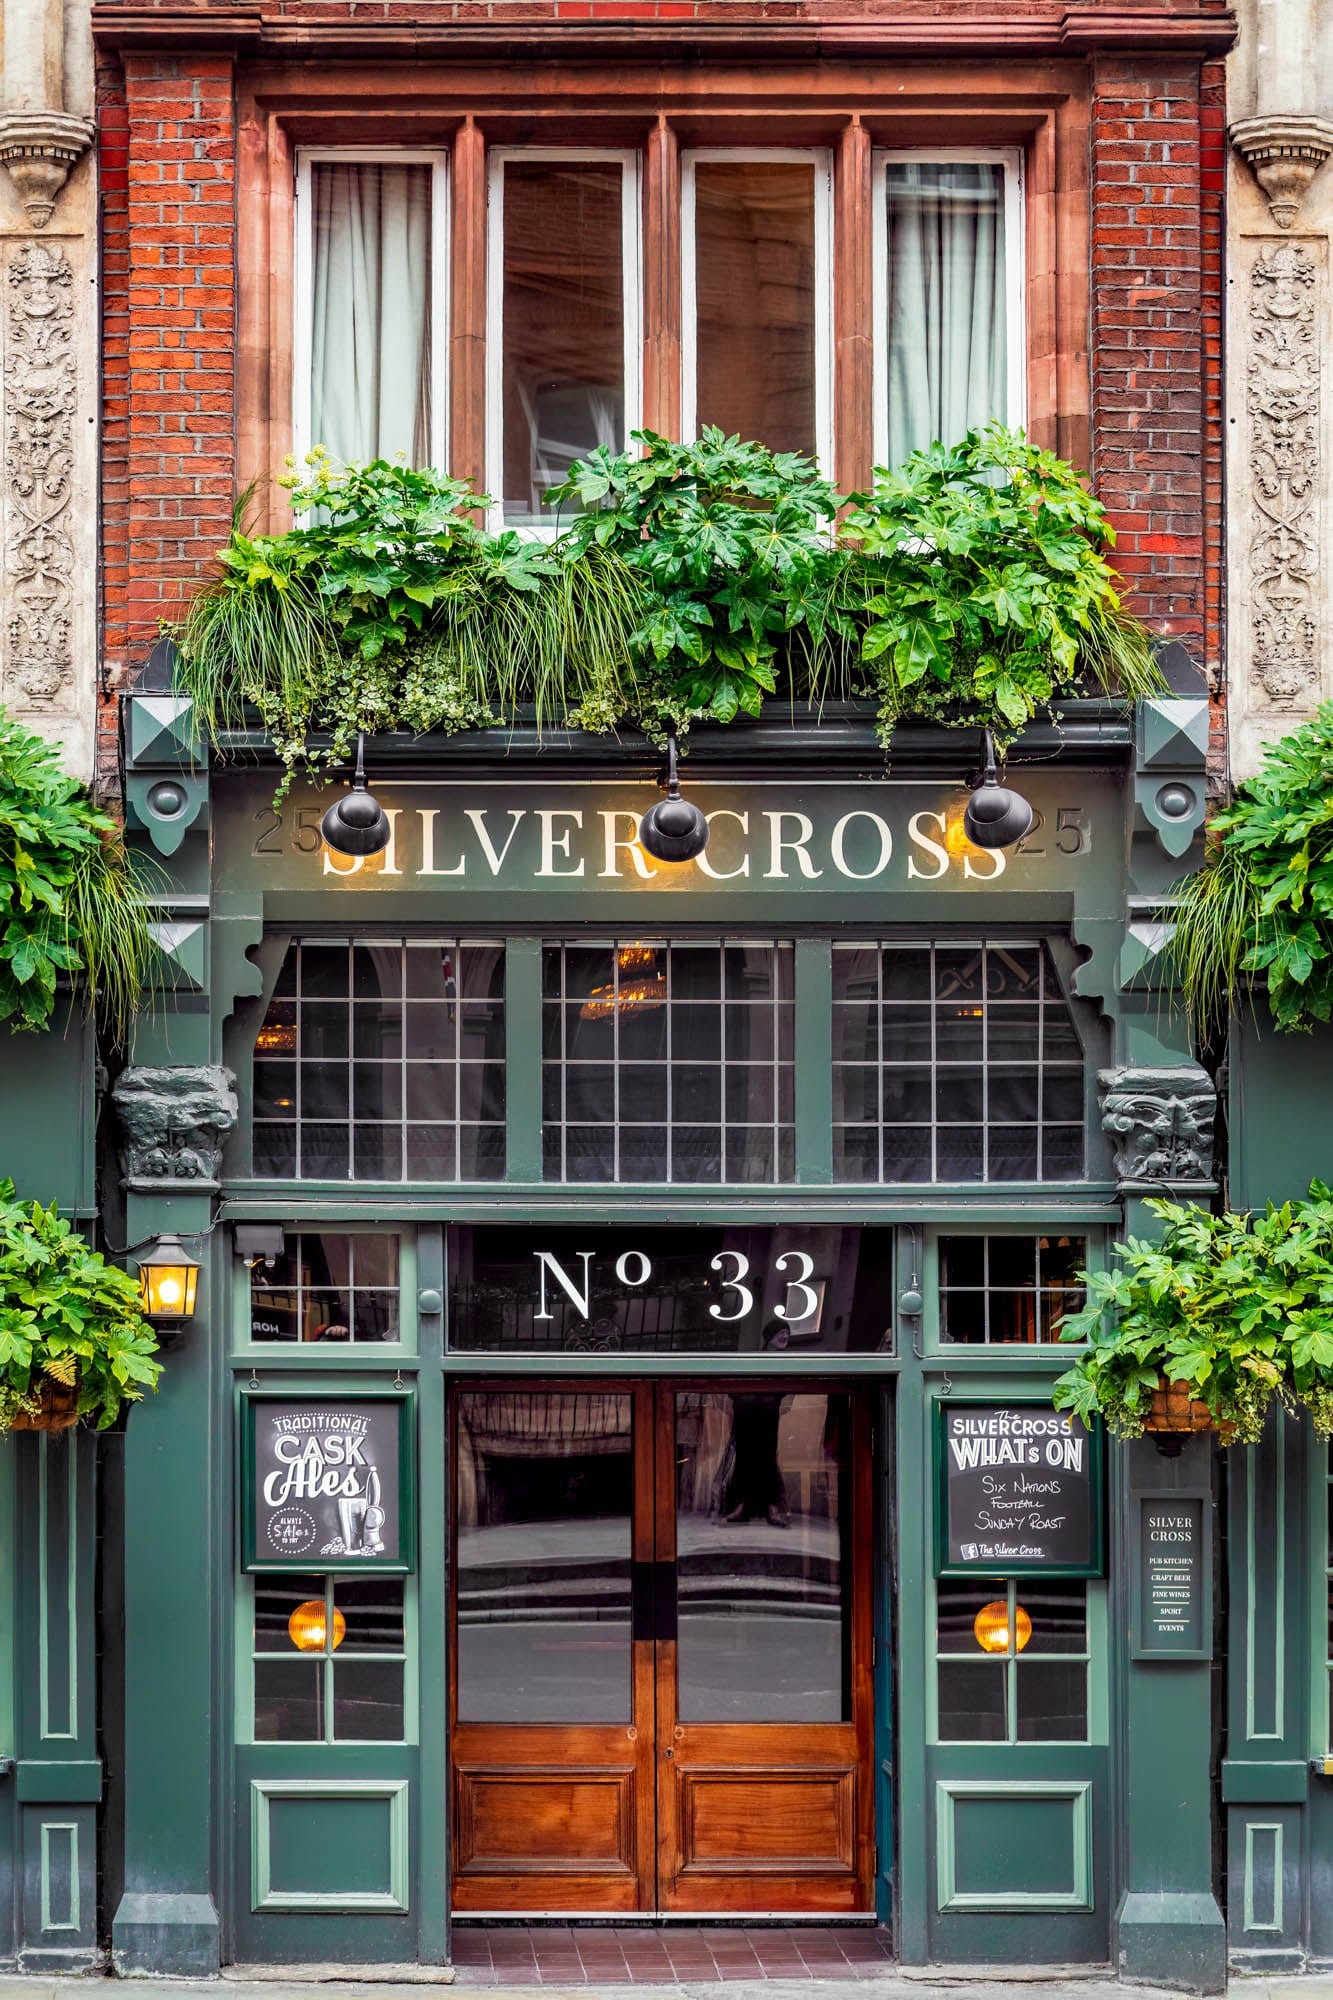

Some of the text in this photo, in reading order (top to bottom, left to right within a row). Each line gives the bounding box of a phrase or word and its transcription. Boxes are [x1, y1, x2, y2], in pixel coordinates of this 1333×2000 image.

[251, 807, 321, 856] 25
[709, 1251, 818, 1320] 33
[994, 1410, 1021, 1421] The
[274, 1416, 368, 1433] TRADITIONAL
[274, 1435, 367, 1465] CASK
[1046, 1438, 1083, 1472] ON
[263, 1457, 365, 1507] Ales
[1149, 1517, 1193, 1528] SILVER
[1150, 1531, 1192, 1542] CROSS
[978, 1544, 994, 1554] The
[994, 1543, 1019, 1555] Silver
[1019, 1544, 1043, 1555] Cross
[1151, 1574, 1191, 1582] CRAFT BEER
